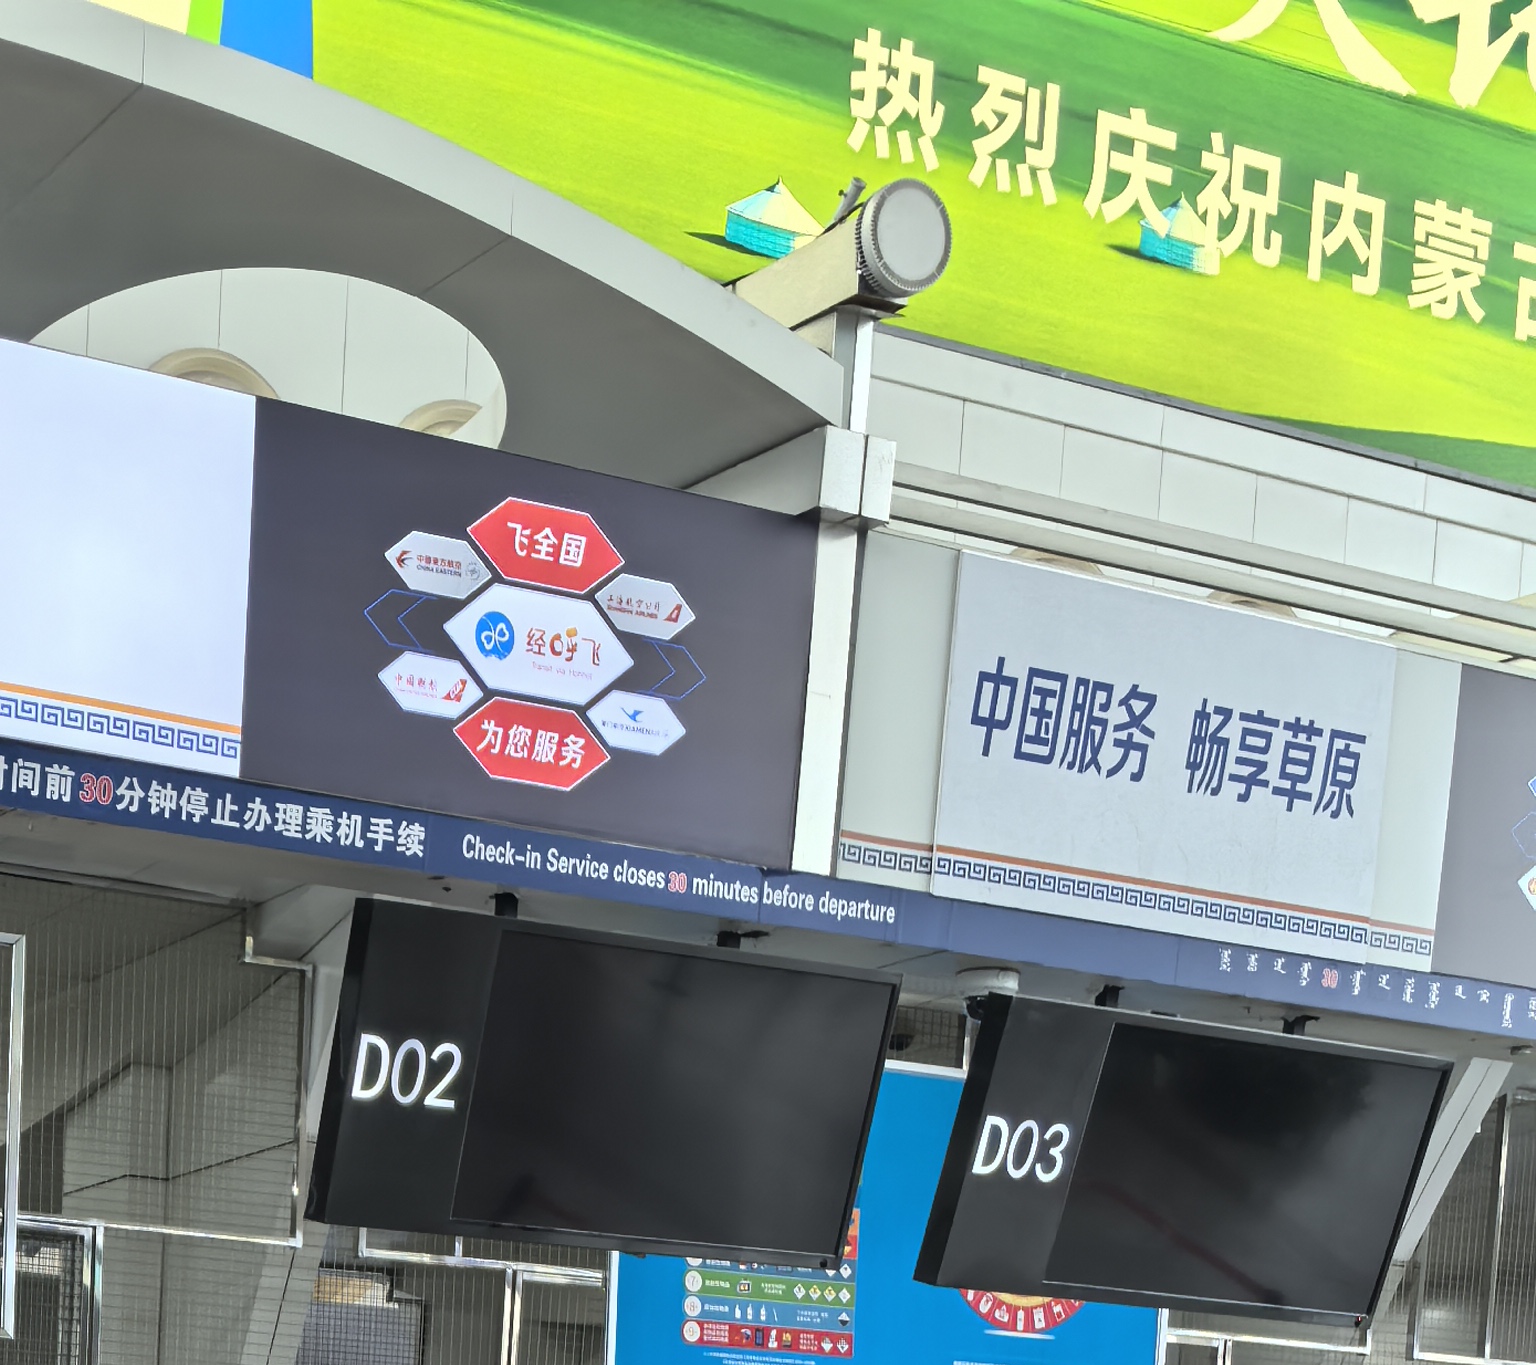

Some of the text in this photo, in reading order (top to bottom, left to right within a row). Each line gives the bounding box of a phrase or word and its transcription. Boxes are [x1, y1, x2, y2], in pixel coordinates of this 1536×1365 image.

[846, 27, 1536, 341] 热烈庆祝内蒙
[506, 521, 587, 568] 飞全国
[476, 718, 586, 770] 为您服务
[970, 656, 1367, 820] 中国服务 畅享草原
[462, 833, 896, 924] Check-in Service closes 30 minutes before departure
[1320, 967, 1340, 990] 30
[351, 1033, 463, 1109] D02
[971, 1114, 1070, 1184] D03
